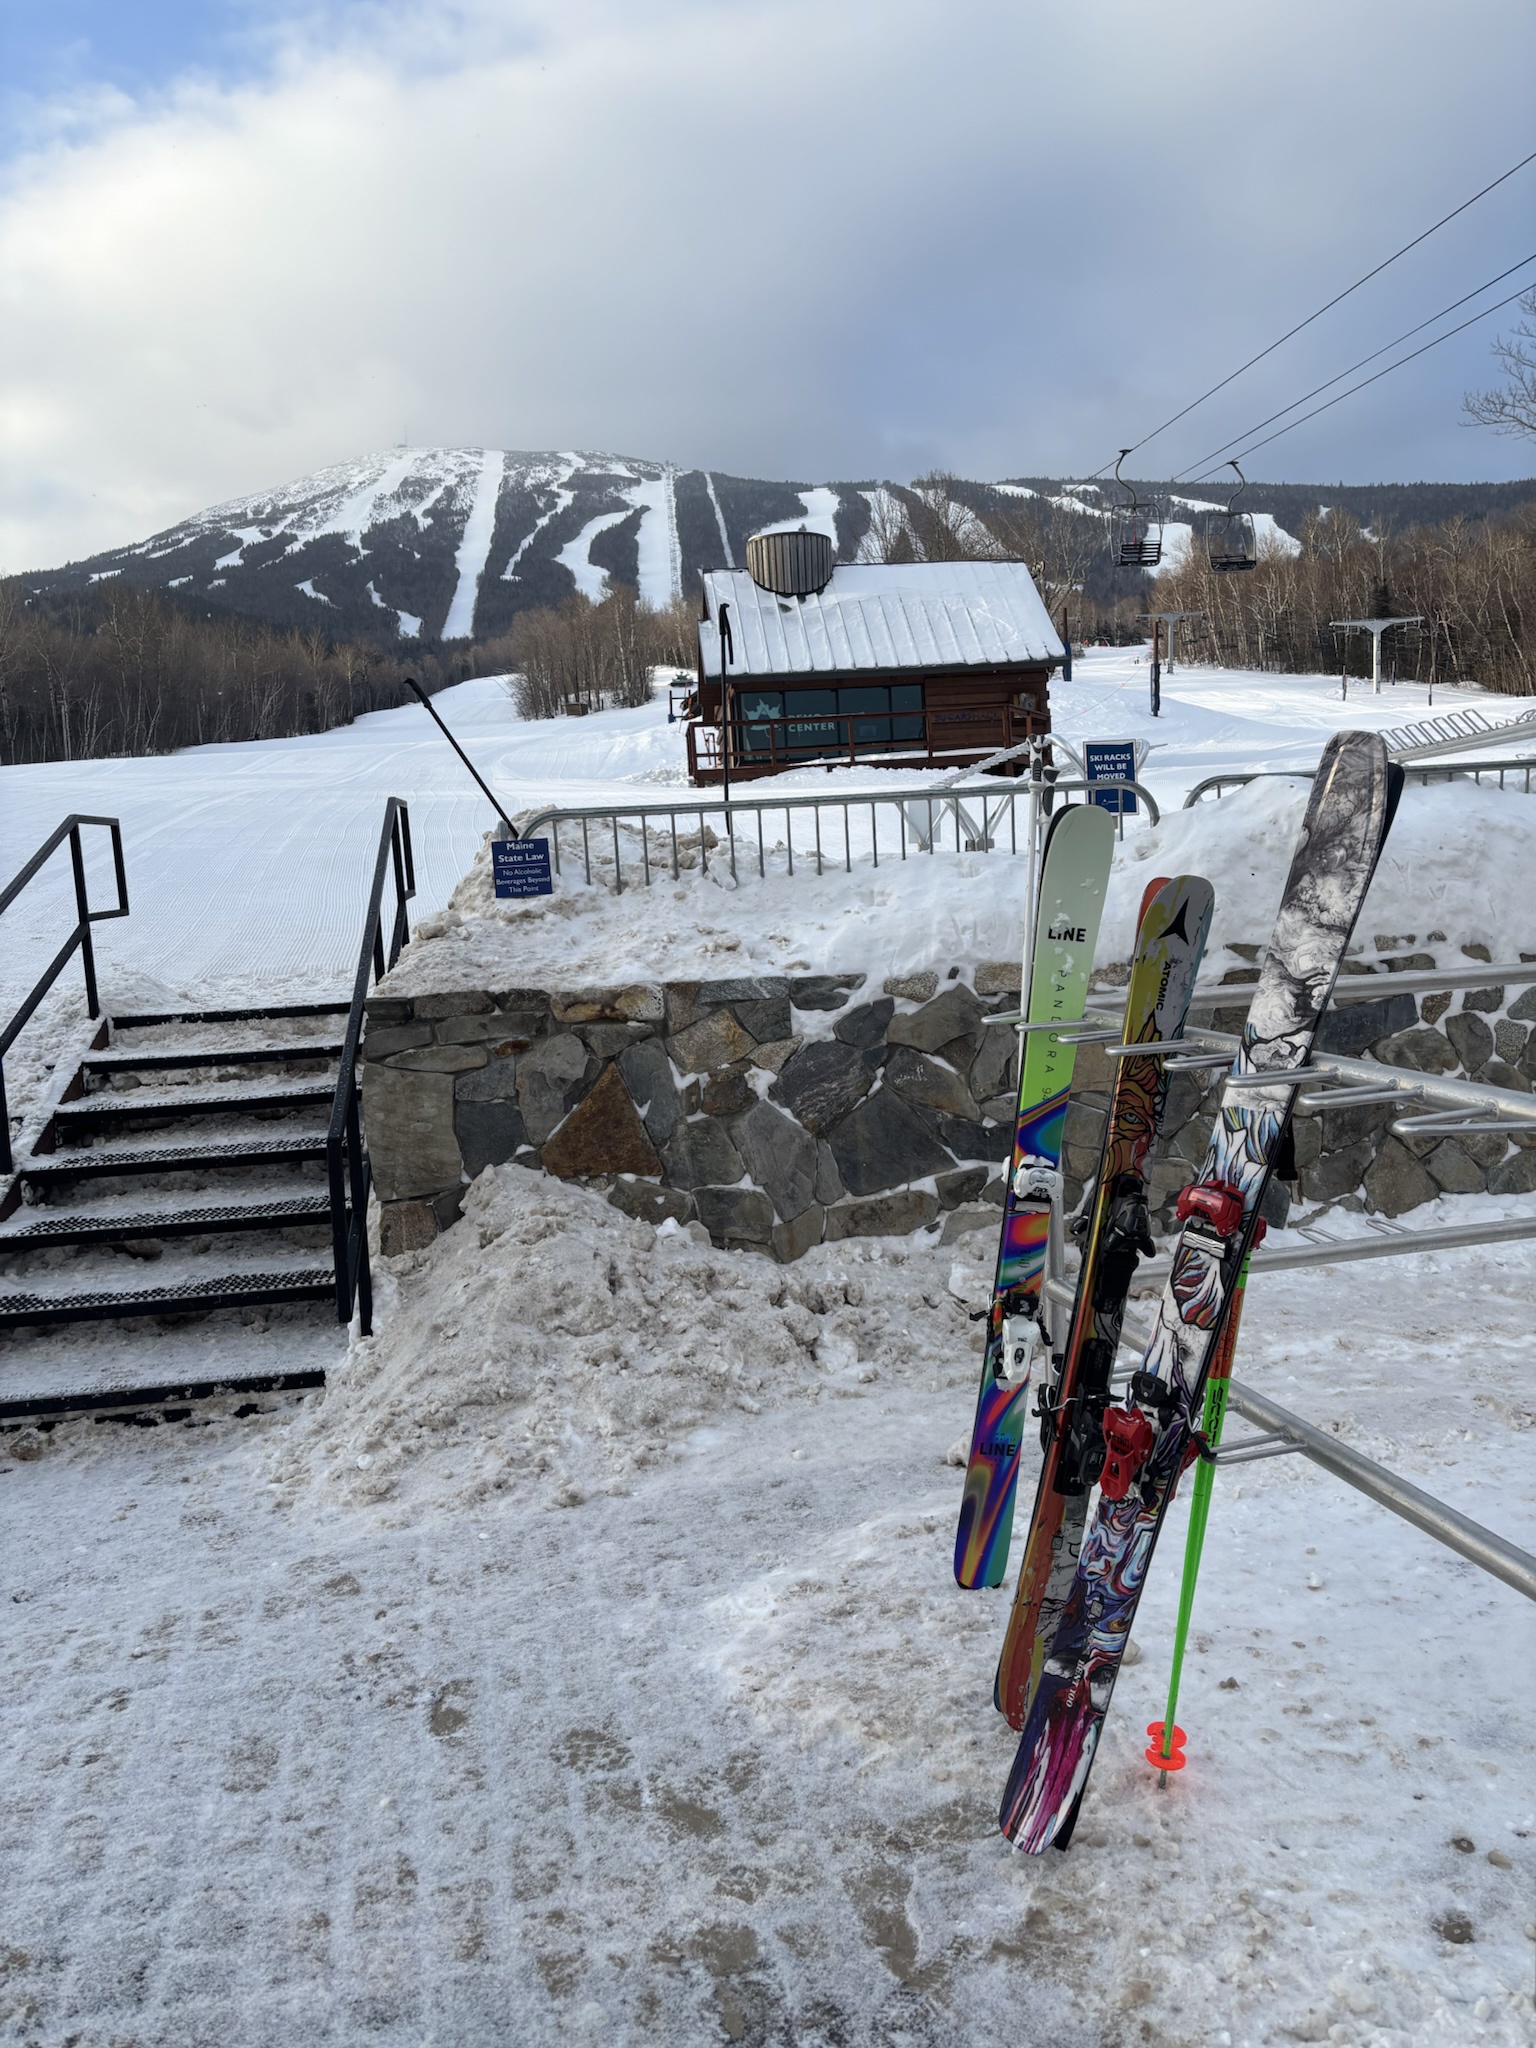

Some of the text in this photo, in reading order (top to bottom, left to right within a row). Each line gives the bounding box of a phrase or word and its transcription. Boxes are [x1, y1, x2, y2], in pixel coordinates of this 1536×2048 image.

[788, 722, 835, 732] CENTER
[1089, 753, 1131, 762] SKI RACKS
[1097, 772, 1126, 780] MOVED
[506, 842, 534, 850] Maine
[498, 853, 544, 863] State Law
[527, 876, 550, 884] Beyond
[1156, 961, 1171, 1011] ATOMIC
[1207, 1386, 1223, 1447] SCOT
[979, 1442, 1016, 1456] LINE
[1065, 1659, 1085, 1708] BENT 100
